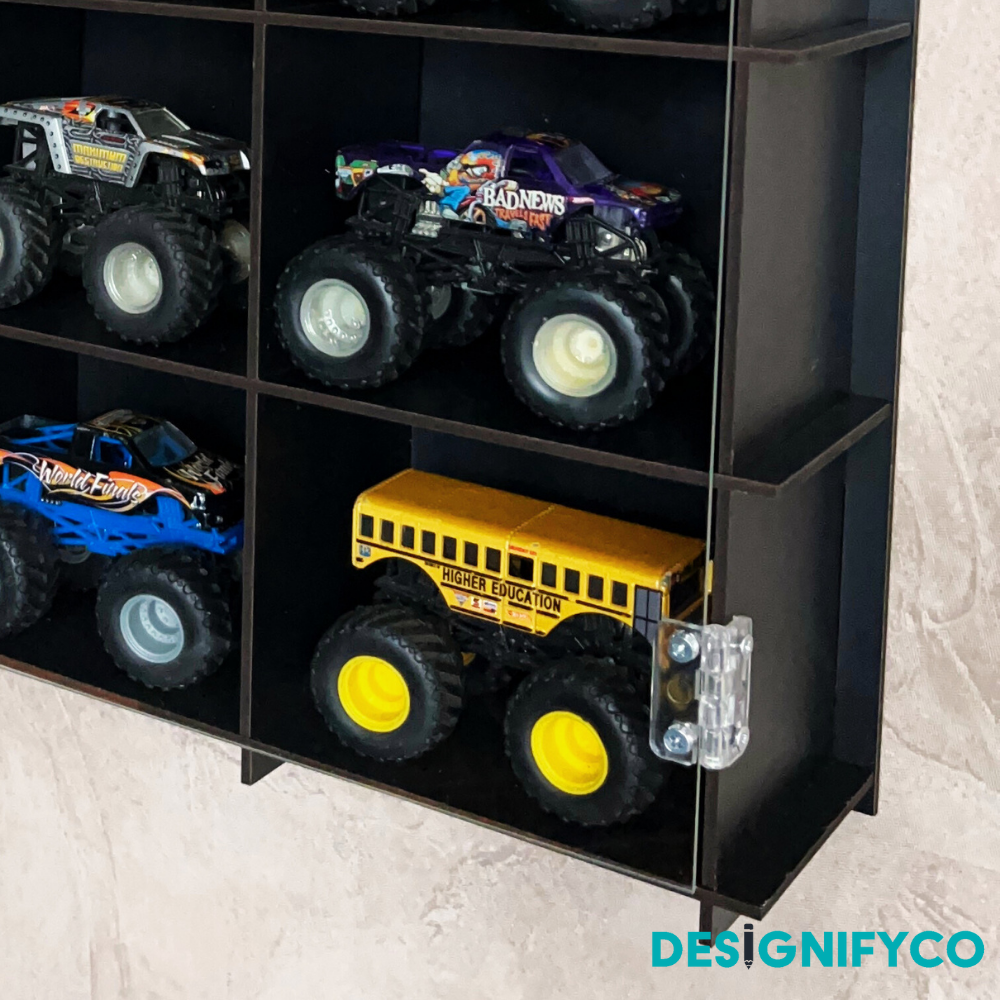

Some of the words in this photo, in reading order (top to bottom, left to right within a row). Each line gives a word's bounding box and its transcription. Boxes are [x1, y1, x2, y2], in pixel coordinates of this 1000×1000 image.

[39, 459, 91, 492] World
[89, 472, 145, 505] Finals
[442, 566, 487, 592] HIGHER
[491, 581, 561, 613] EDUCATION
